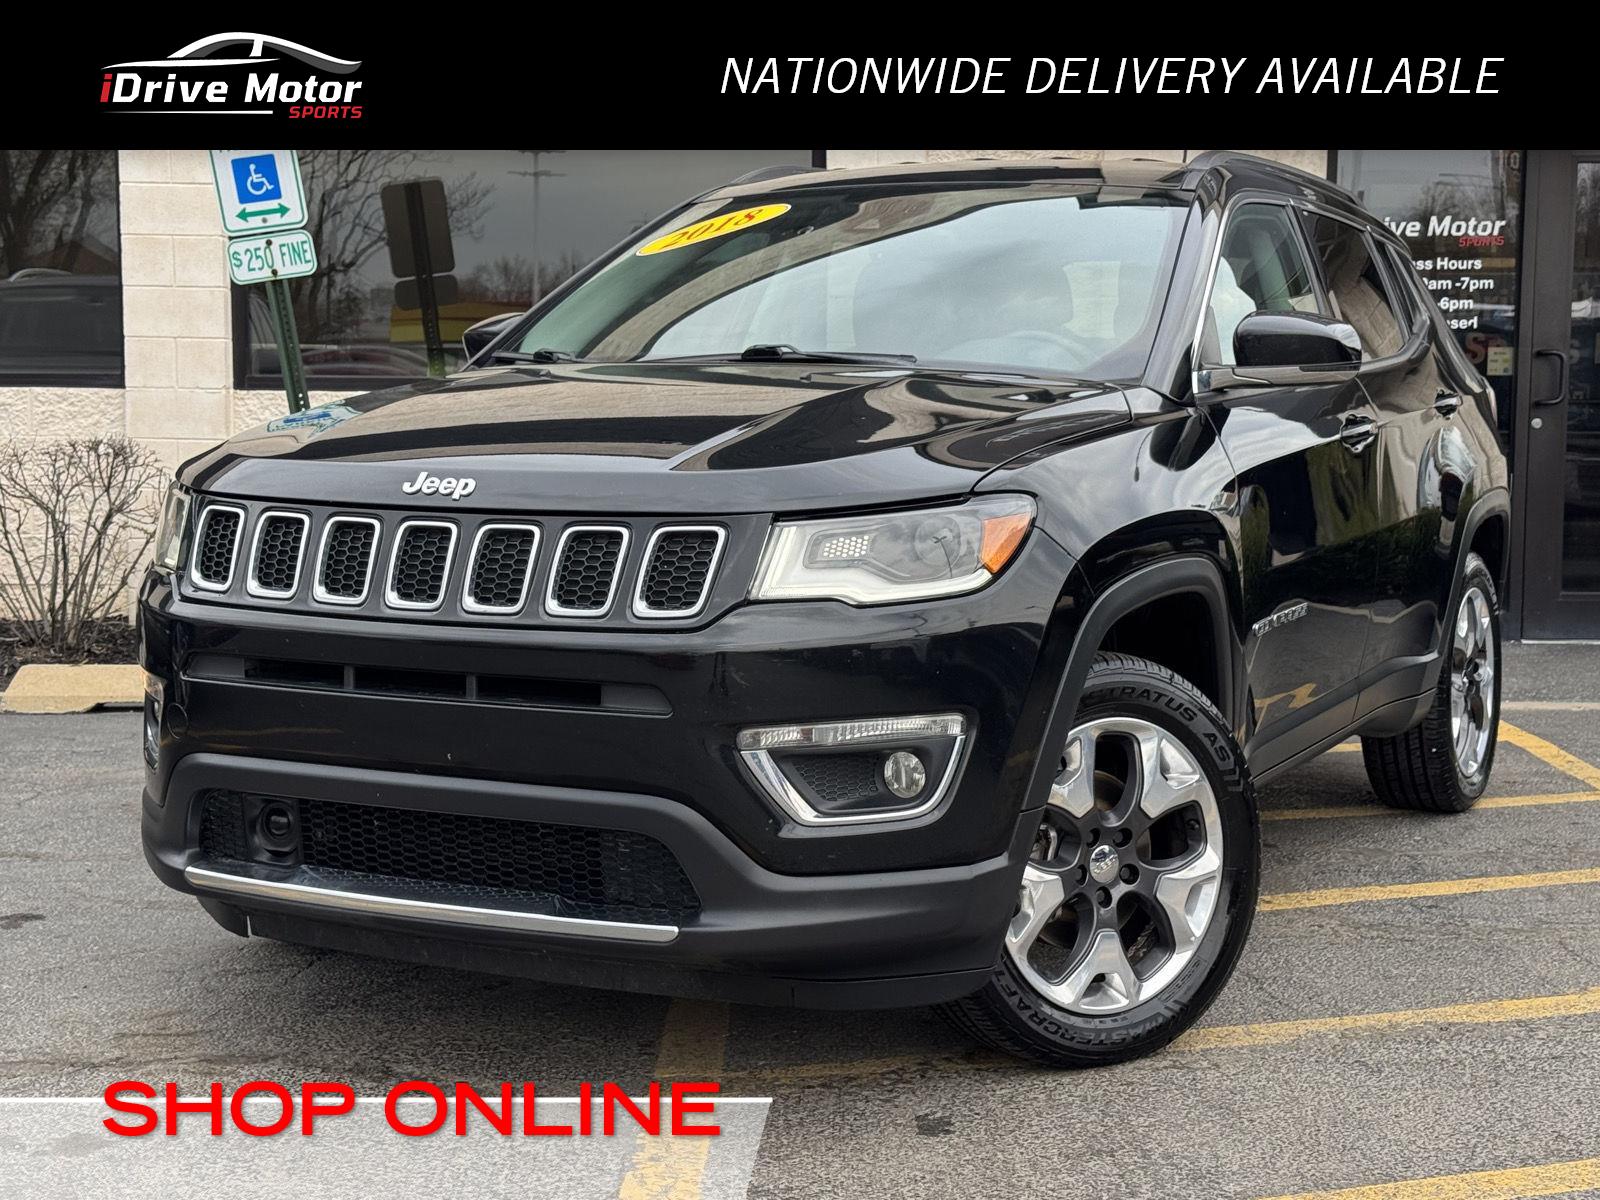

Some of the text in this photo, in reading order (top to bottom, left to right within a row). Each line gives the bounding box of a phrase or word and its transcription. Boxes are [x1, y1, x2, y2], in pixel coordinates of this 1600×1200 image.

[659, 208, 764, 249] 2018
[1426, 215, 1506, 237] Motor
[231, 240, 312, 273] $250 FINE
[1436, 257, 1482, 270] Hours
[402, 471, 476, 501] Jeep
